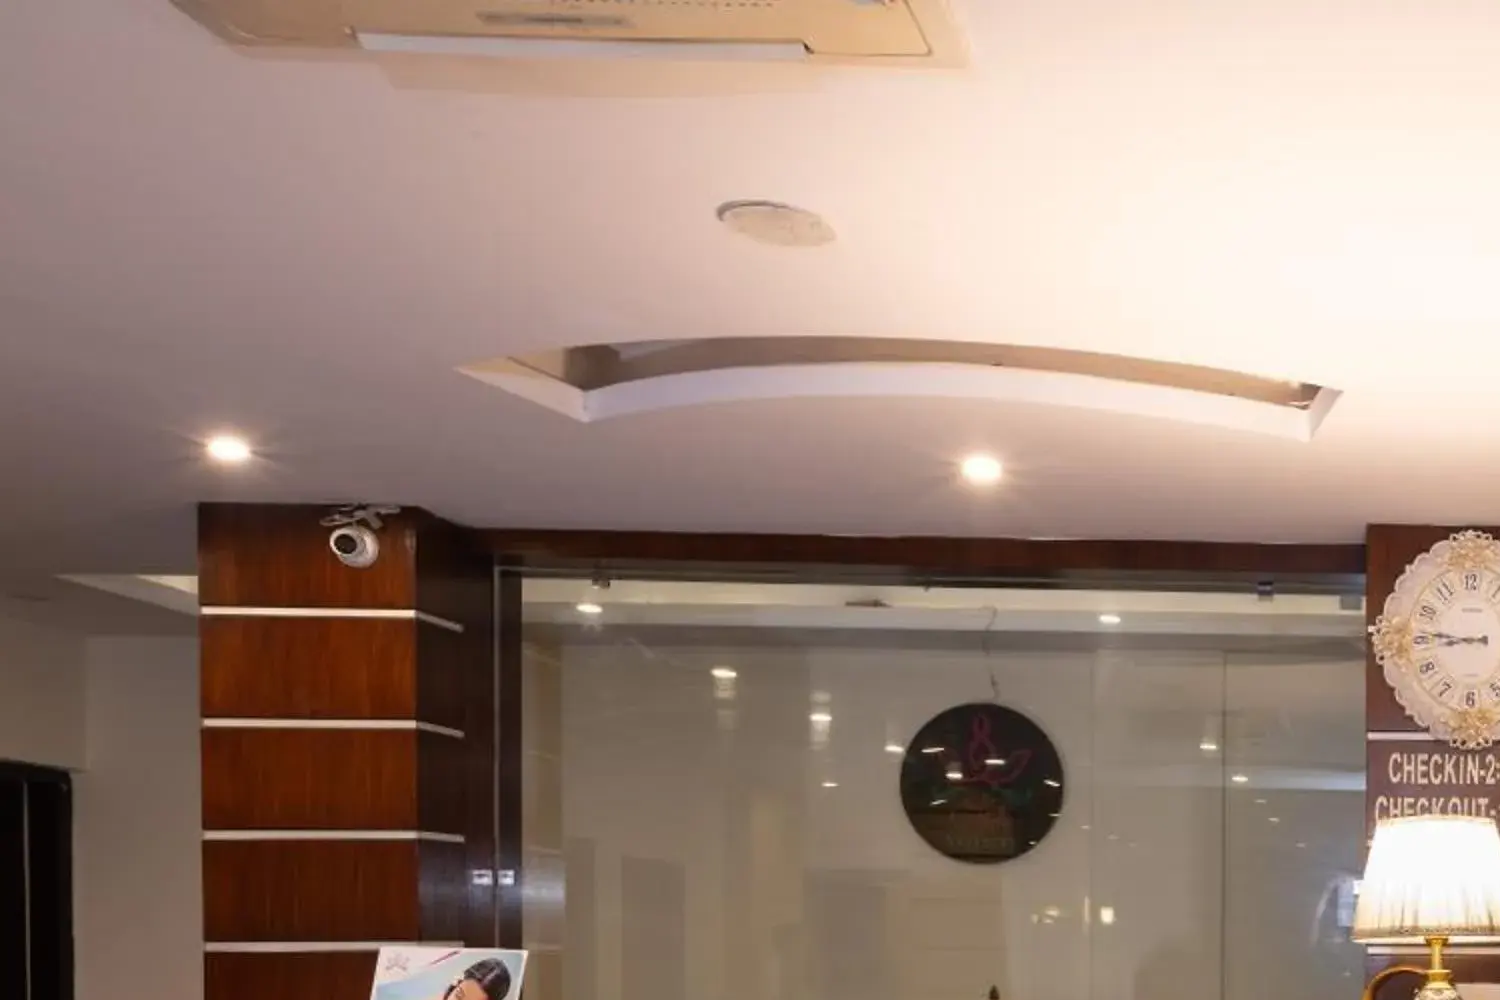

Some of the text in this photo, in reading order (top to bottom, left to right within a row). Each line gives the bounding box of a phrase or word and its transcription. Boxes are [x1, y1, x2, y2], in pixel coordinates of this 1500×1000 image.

[1464, 574, 1477, 590] 12
[1436, 581, 1454, 601] 11
[1419, 605, 1436, 620] 10
[1419, 661, 1435, 674] 8
[1439, 681, 1452, 697] 7
[1465, 691, 1475, 707] 6
